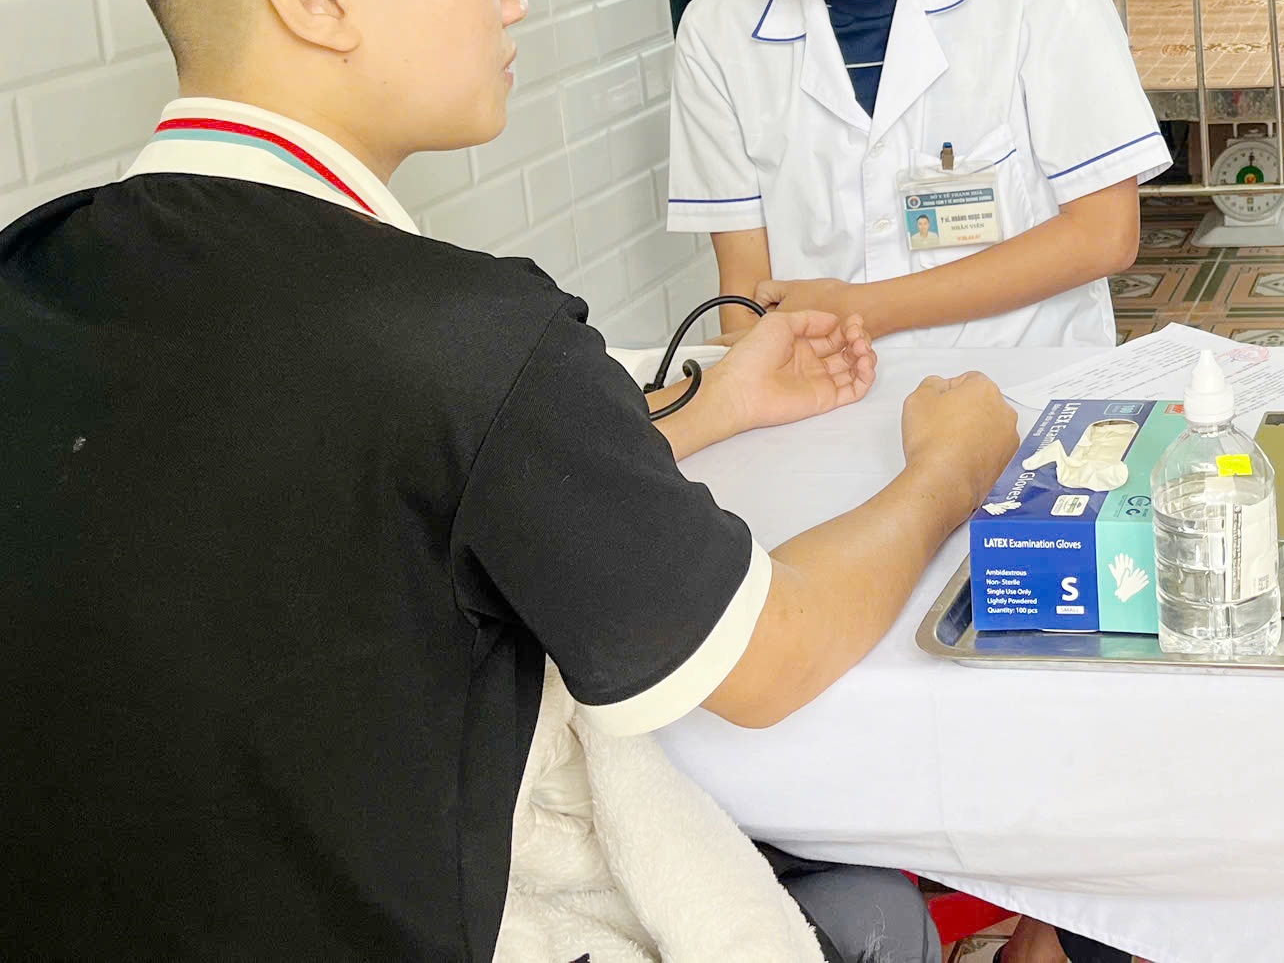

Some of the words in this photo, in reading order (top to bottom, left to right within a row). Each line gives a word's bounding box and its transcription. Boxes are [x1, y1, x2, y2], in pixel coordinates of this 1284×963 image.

[1054, 402, 1081, 425] LATEX
[1006, 472, 1036, 500] Gloves
[984, 538, 1008, 548] LATEX
[1009, 538, 1055, 549] Examination
[1056, 539, 1081, 550] Gloves
[987, 588, 1005, 596] Single
[1061, 576, 1079, 601] S
[987, 598, 1007, 606] Lightly
